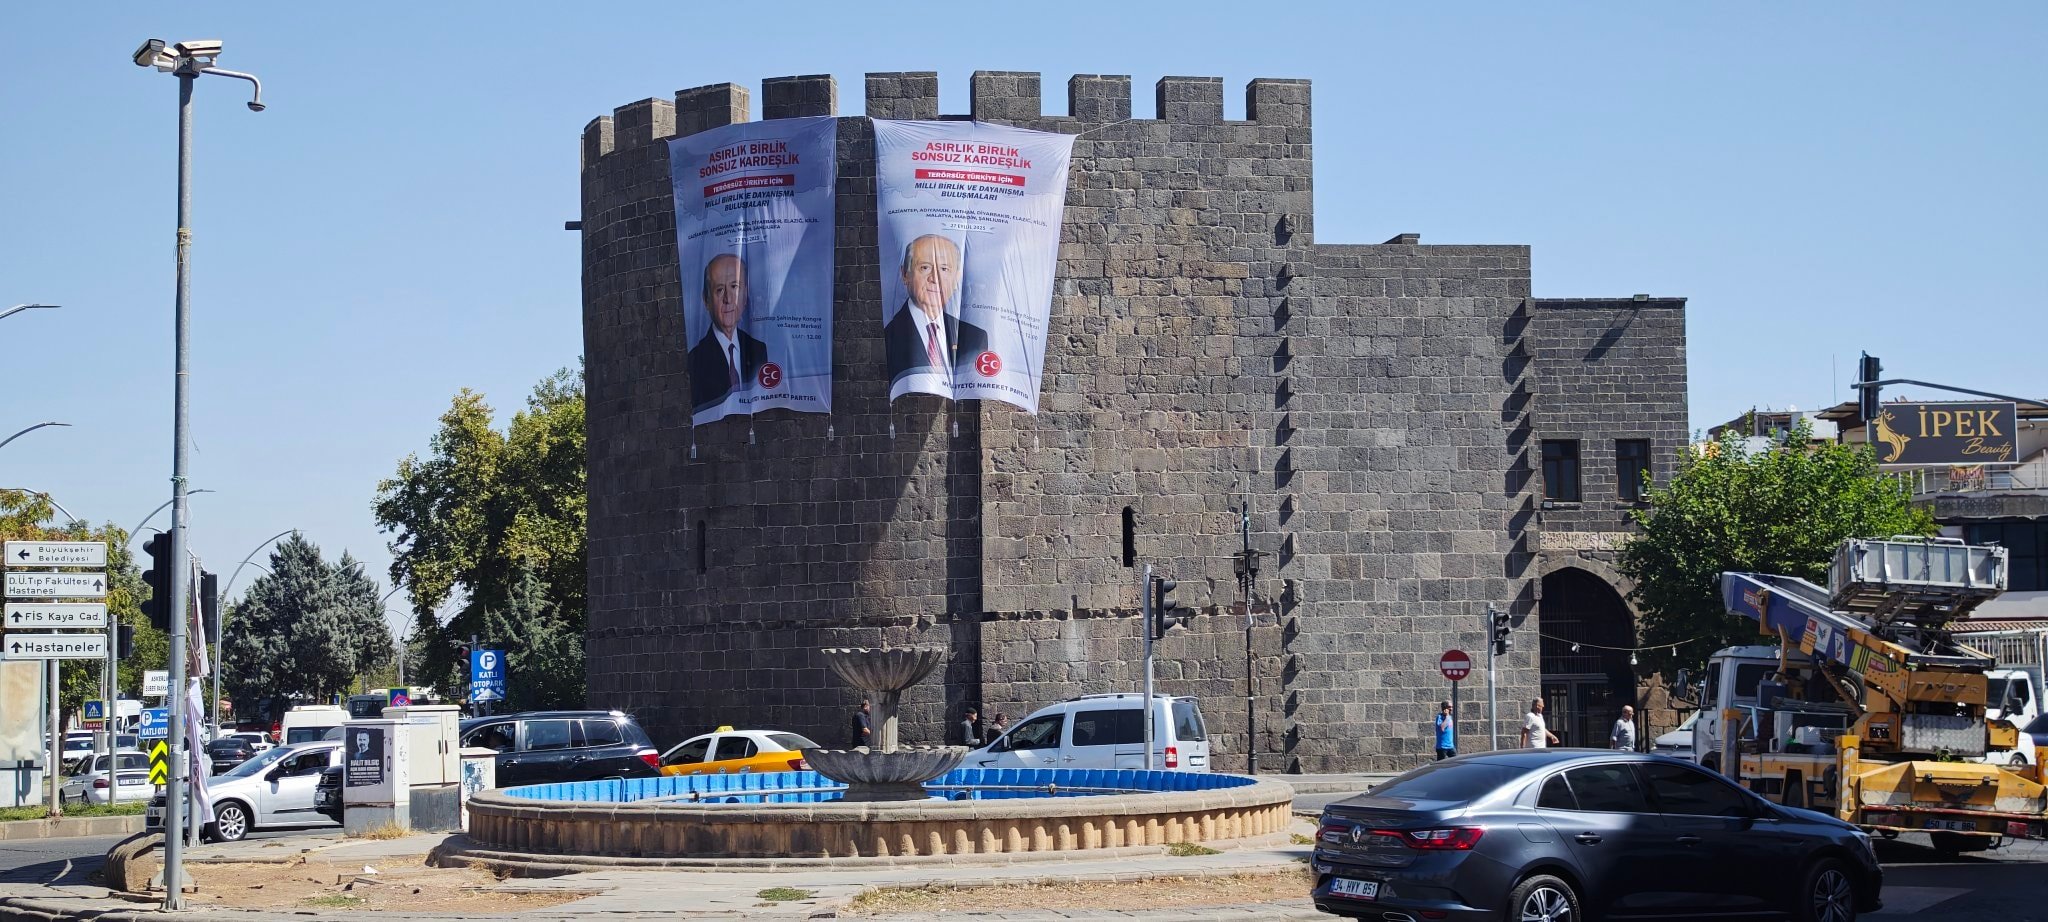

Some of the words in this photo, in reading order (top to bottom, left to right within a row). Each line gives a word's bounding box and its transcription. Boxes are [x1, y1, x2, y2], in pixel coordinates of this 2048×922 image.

[709, 145, 746, 164] ASIRLIK
[750, 140, 787, 154] BİRLİK
[926, 142, 974, 154] ASIRLIK
[978, 144, 1019, 158] BİRLİK
[700, 162, 736, 178] SONSUZ
[740, 152, 800, 168] KARDEŞLİK
[912, 152, 960, 163] SONSUZ
[964, 154, 1032, 169] KARDEŞLİK
[744, 178, 768, 187] ÜRKİYE
[928, 171, 966, 180] TERÖRSÜZ
[967, 172, 997, 182] TÜRKİYE
[998, 174, 1013, 184] İÇİN
[914, 181, 937, 190] MİLLİ
[938, 182, 964, 190] BİRLİK
[978, 186, 1024, 197] DAYANIŞMA
[704, 196, 721, 209] MİLLİ
[722, 193, 744, 204] BİRLİK
[752, 189, 794, 200] DAYANIŞMA
[941, 190, 998, 201] BULUŞMALARI
[724, 200, 770, 212] BULUŞALARI
[978, 383, 1008, 392] HAREKET
[1918, 406, 2002, 437] İPEK
[1962, 437, 2013, 462] Beauty
[38, 546, 94, 554] Büyükşehir
[45, 577, 90, 585] Fakültesi
[26, 611, 42, 620] FİS
[48, 612, 74, 622] Kaya
[80, 612, 100, 620] Cad.
[25, 642, 100, 652] Hastaneler
[474, 680, 503, 688] OTOPARK
[142, 728, 156, 736] KATLI
[158, 728, 168, 736] OTO
[1334, 879, 1344, 892] 34
[1346, 880, 1360, 893] HVY
[1362, 882, 1376, 896] 851
